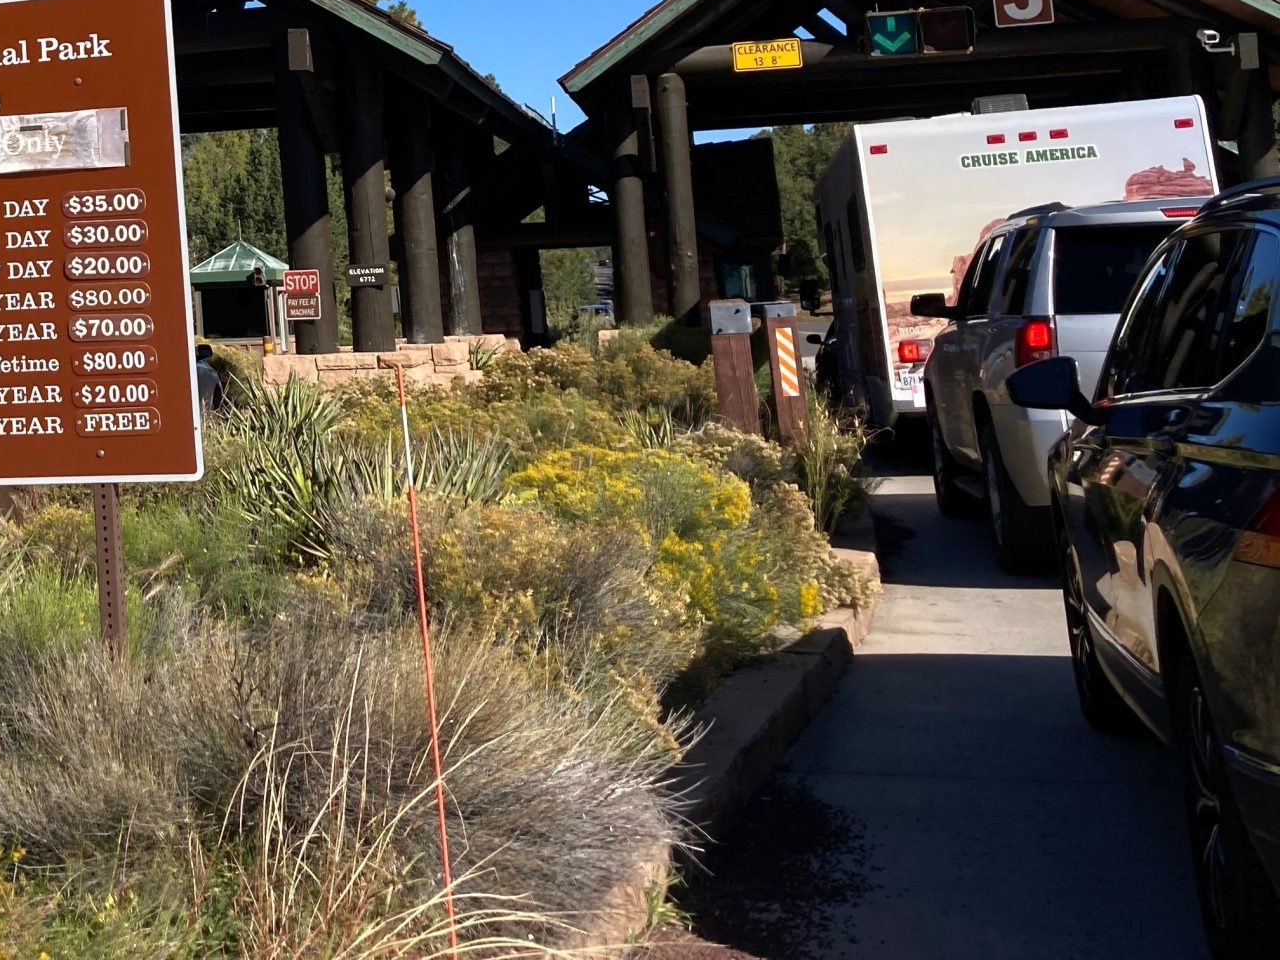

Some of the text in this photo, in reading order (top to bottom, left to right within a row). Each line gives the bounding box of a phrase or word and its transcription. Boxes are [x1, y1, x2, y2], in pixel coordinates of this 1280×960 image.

[37, 34, 112, 62] Park
[737, 42, 797, 55] CLEARANCE
[4, 131, 65, 158] Only
[960, 145, 1098, 168] CRUISE AMERICA
[4, 199, 49, 218] DAY
[69, 193, 140, 214] $35.00
[5, 230, 51, 248] DAY
[71, 224, 141, 245] $30.00
[7, 260, 53, 279] DAY
[72, 256, 143, 276] $20.00
[348, 267, 384, 275] ELEVATION
[286, 275, 317, 290] STOP
[70, 288, 145, 308] $80.00
[299, 298, 309, 306] FEE
[290, 308, 315, 316] MACHINE
[74, 318, 145, 339] $70.00
[83, 351, 145, 372] $80.00
[82, 384, 148, 404] $20.00
[84, 412, 150, 431] FREE
